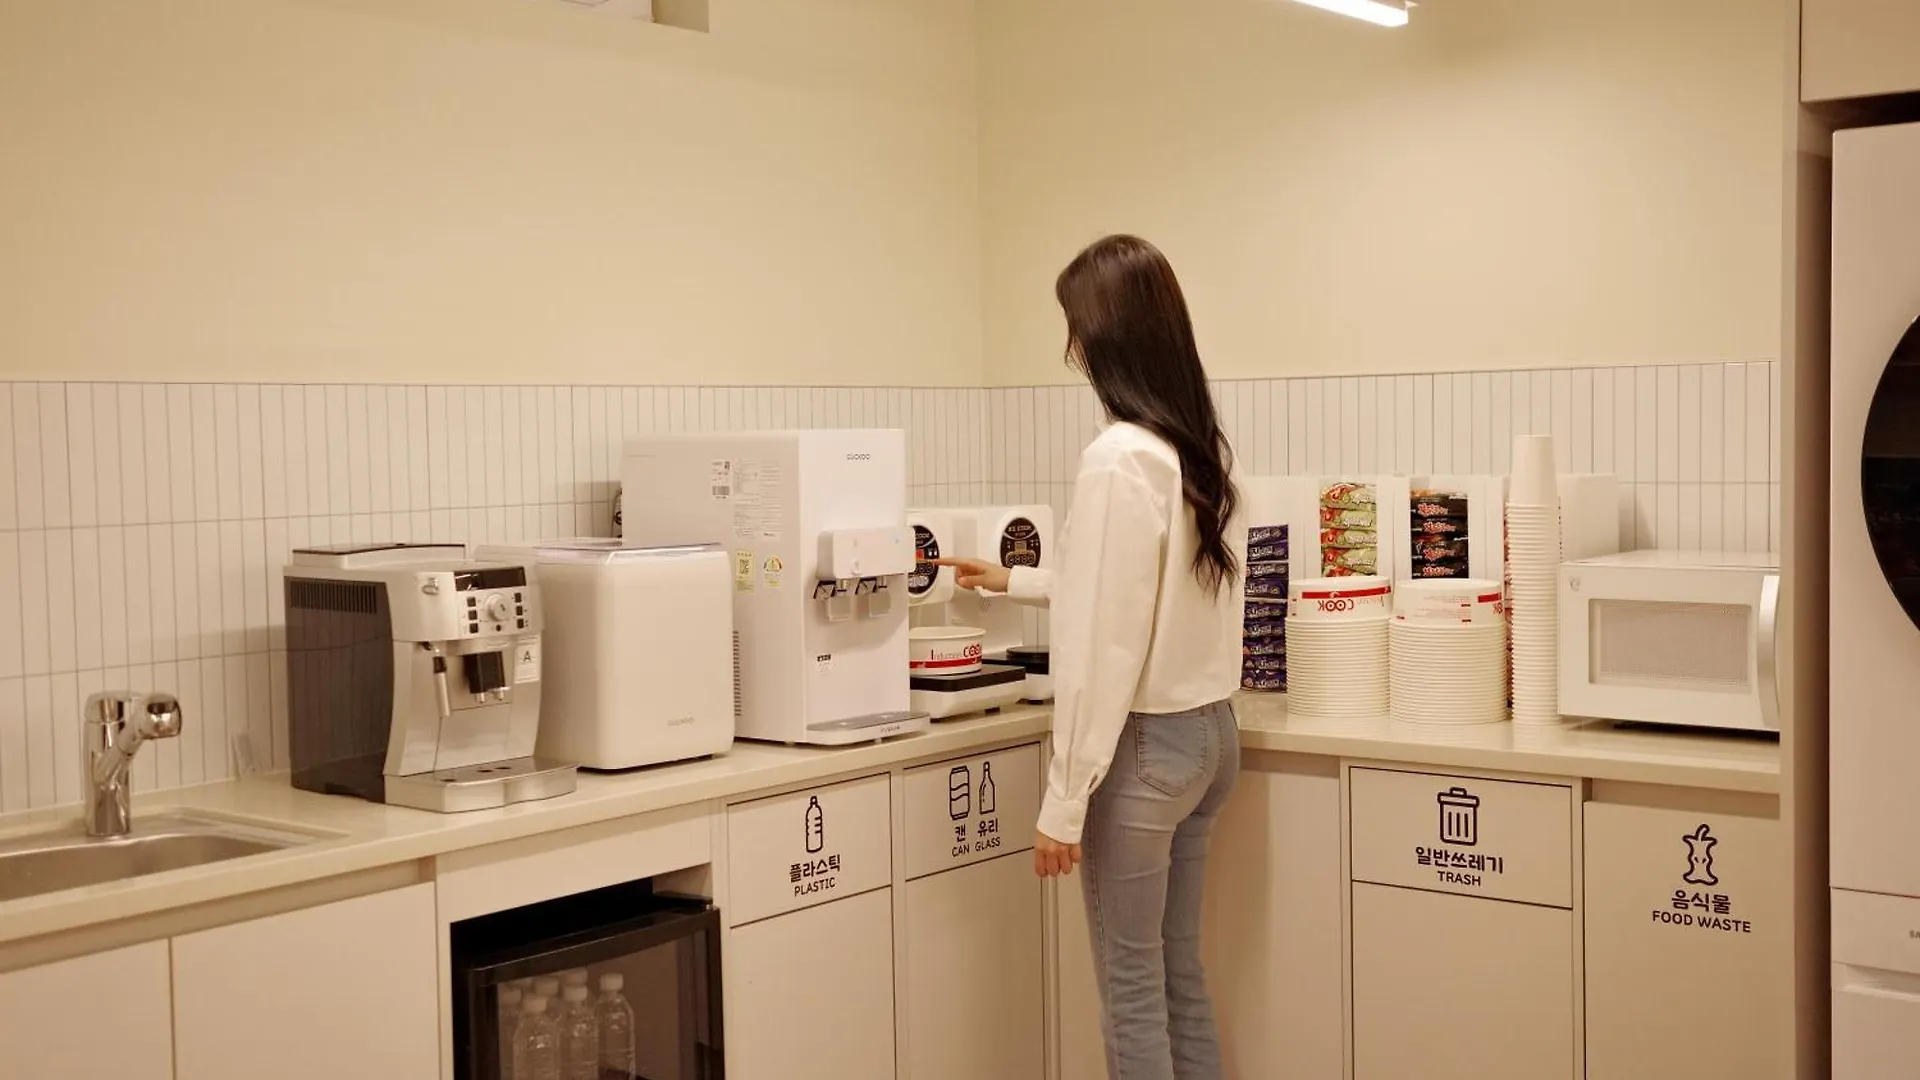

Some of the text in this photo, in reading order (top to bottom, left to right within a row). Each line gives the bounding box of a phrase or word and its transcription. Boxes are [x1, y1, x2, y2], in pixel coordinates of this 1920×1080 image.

[1317, 599, 1355, 612] COOK
[954, 817, 998, 843] 캔 유리
[951, 836, 1001, 857] CAN GLASS
[789, 854, 840, 883] 플라스틱
[1415, 846, 1503, 875] 일반쓰레기
[794, 877, 836, 897] PLASTIC
[1437, 870, 1481, 887] TRASH
[1671, 889, 1731, 915] 음식물
[1652, 910, 1751, 933] FOOD WASTE
